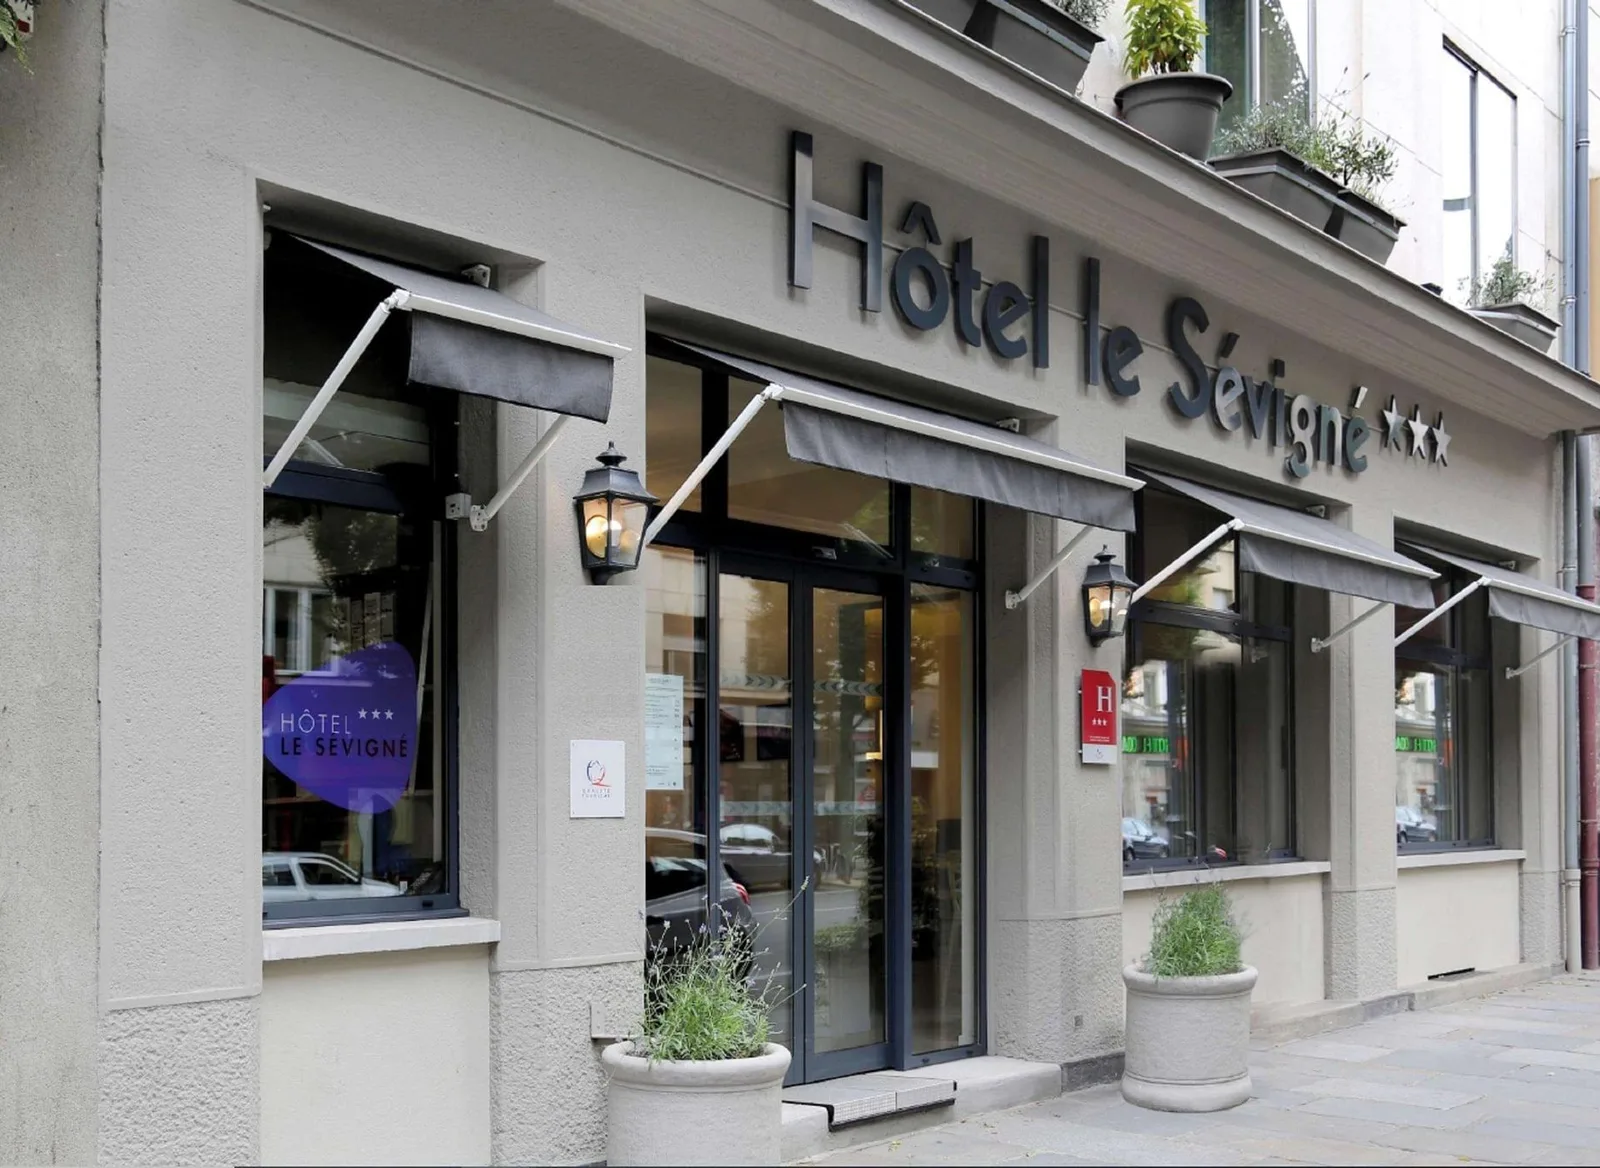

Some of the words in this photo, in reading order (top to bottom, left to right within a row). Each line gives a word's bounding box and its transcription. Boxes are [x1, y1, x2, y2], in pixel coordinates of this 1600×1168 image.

[788, 130, 1049, 369] Hôtel
[1083, 257, 1143, 397] le
[1168, 297, 1370, 478] Sévigné
[1096, 685, 1113, 712] H
[280, 709, 352, 735] HÔTEL
[280, 737, 302, 756] LE
[315, 733, 408, 758] SÉVIGNÉ
